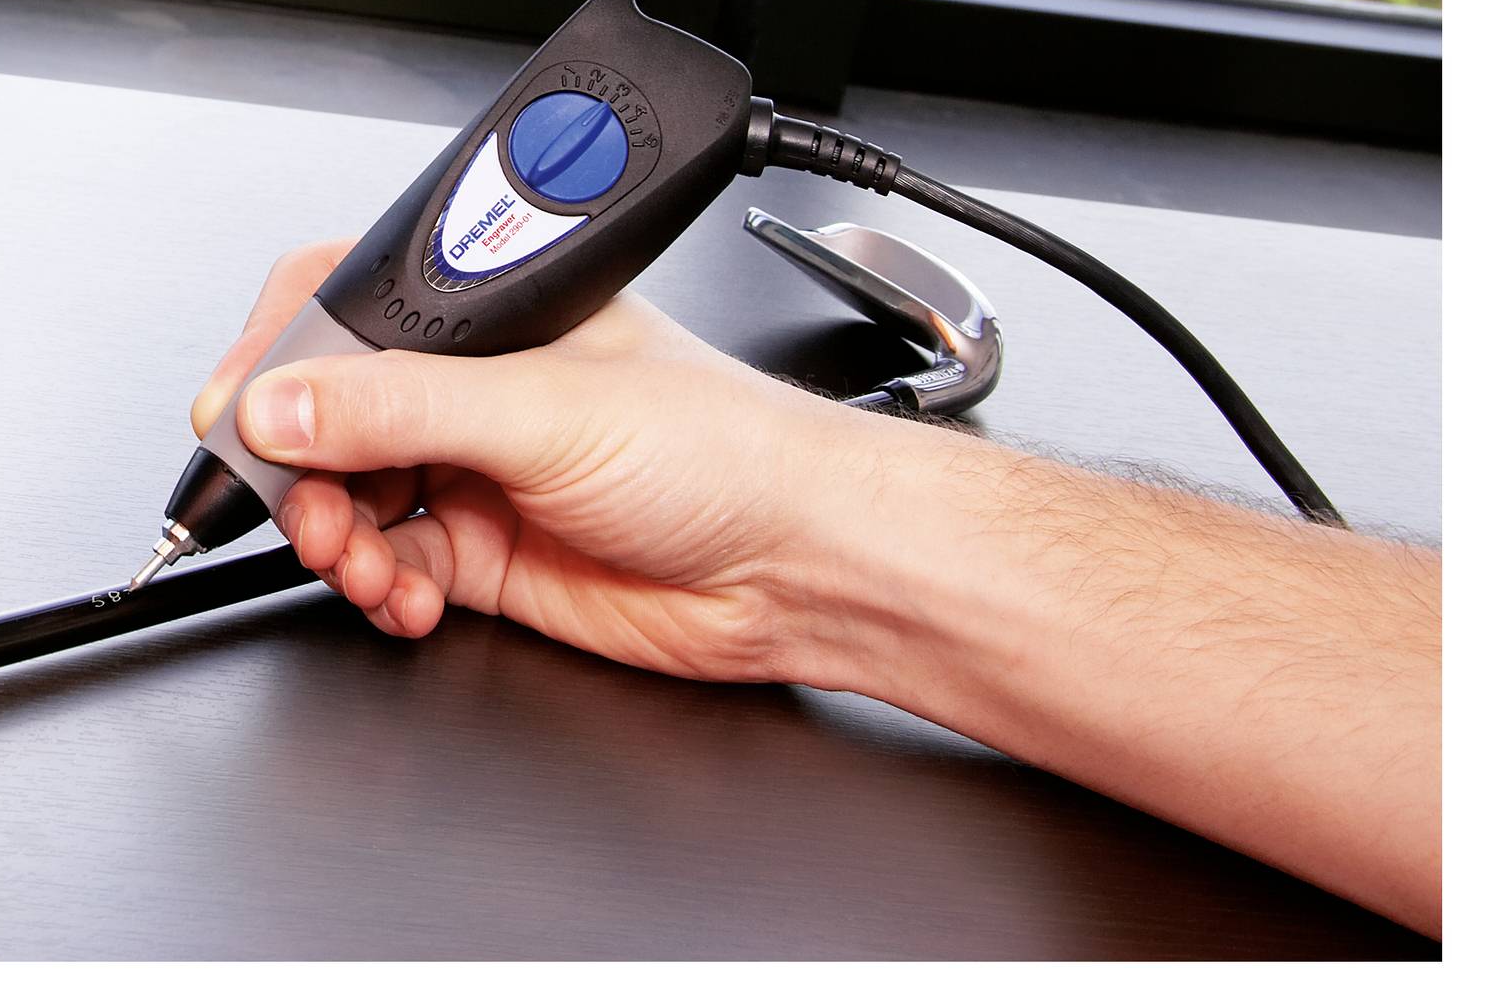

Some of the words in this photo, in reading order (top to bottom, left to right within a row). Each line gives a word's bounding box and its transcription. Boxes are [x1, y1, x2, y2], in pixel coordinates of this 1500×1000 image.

[564, 65, 576, 75] 1
[590, 68, 606, 83] 2
[616, 83, 631, 97] 3
[635, 104, 648, 118] 4
[644, 133, 659, 148] 5
[449, 198, 516, 260] DREMEL
[481, 213, 516, 247] Engraver
[489, 233, 511, 254] Model
[509, 212, 533, 236] 290-01
